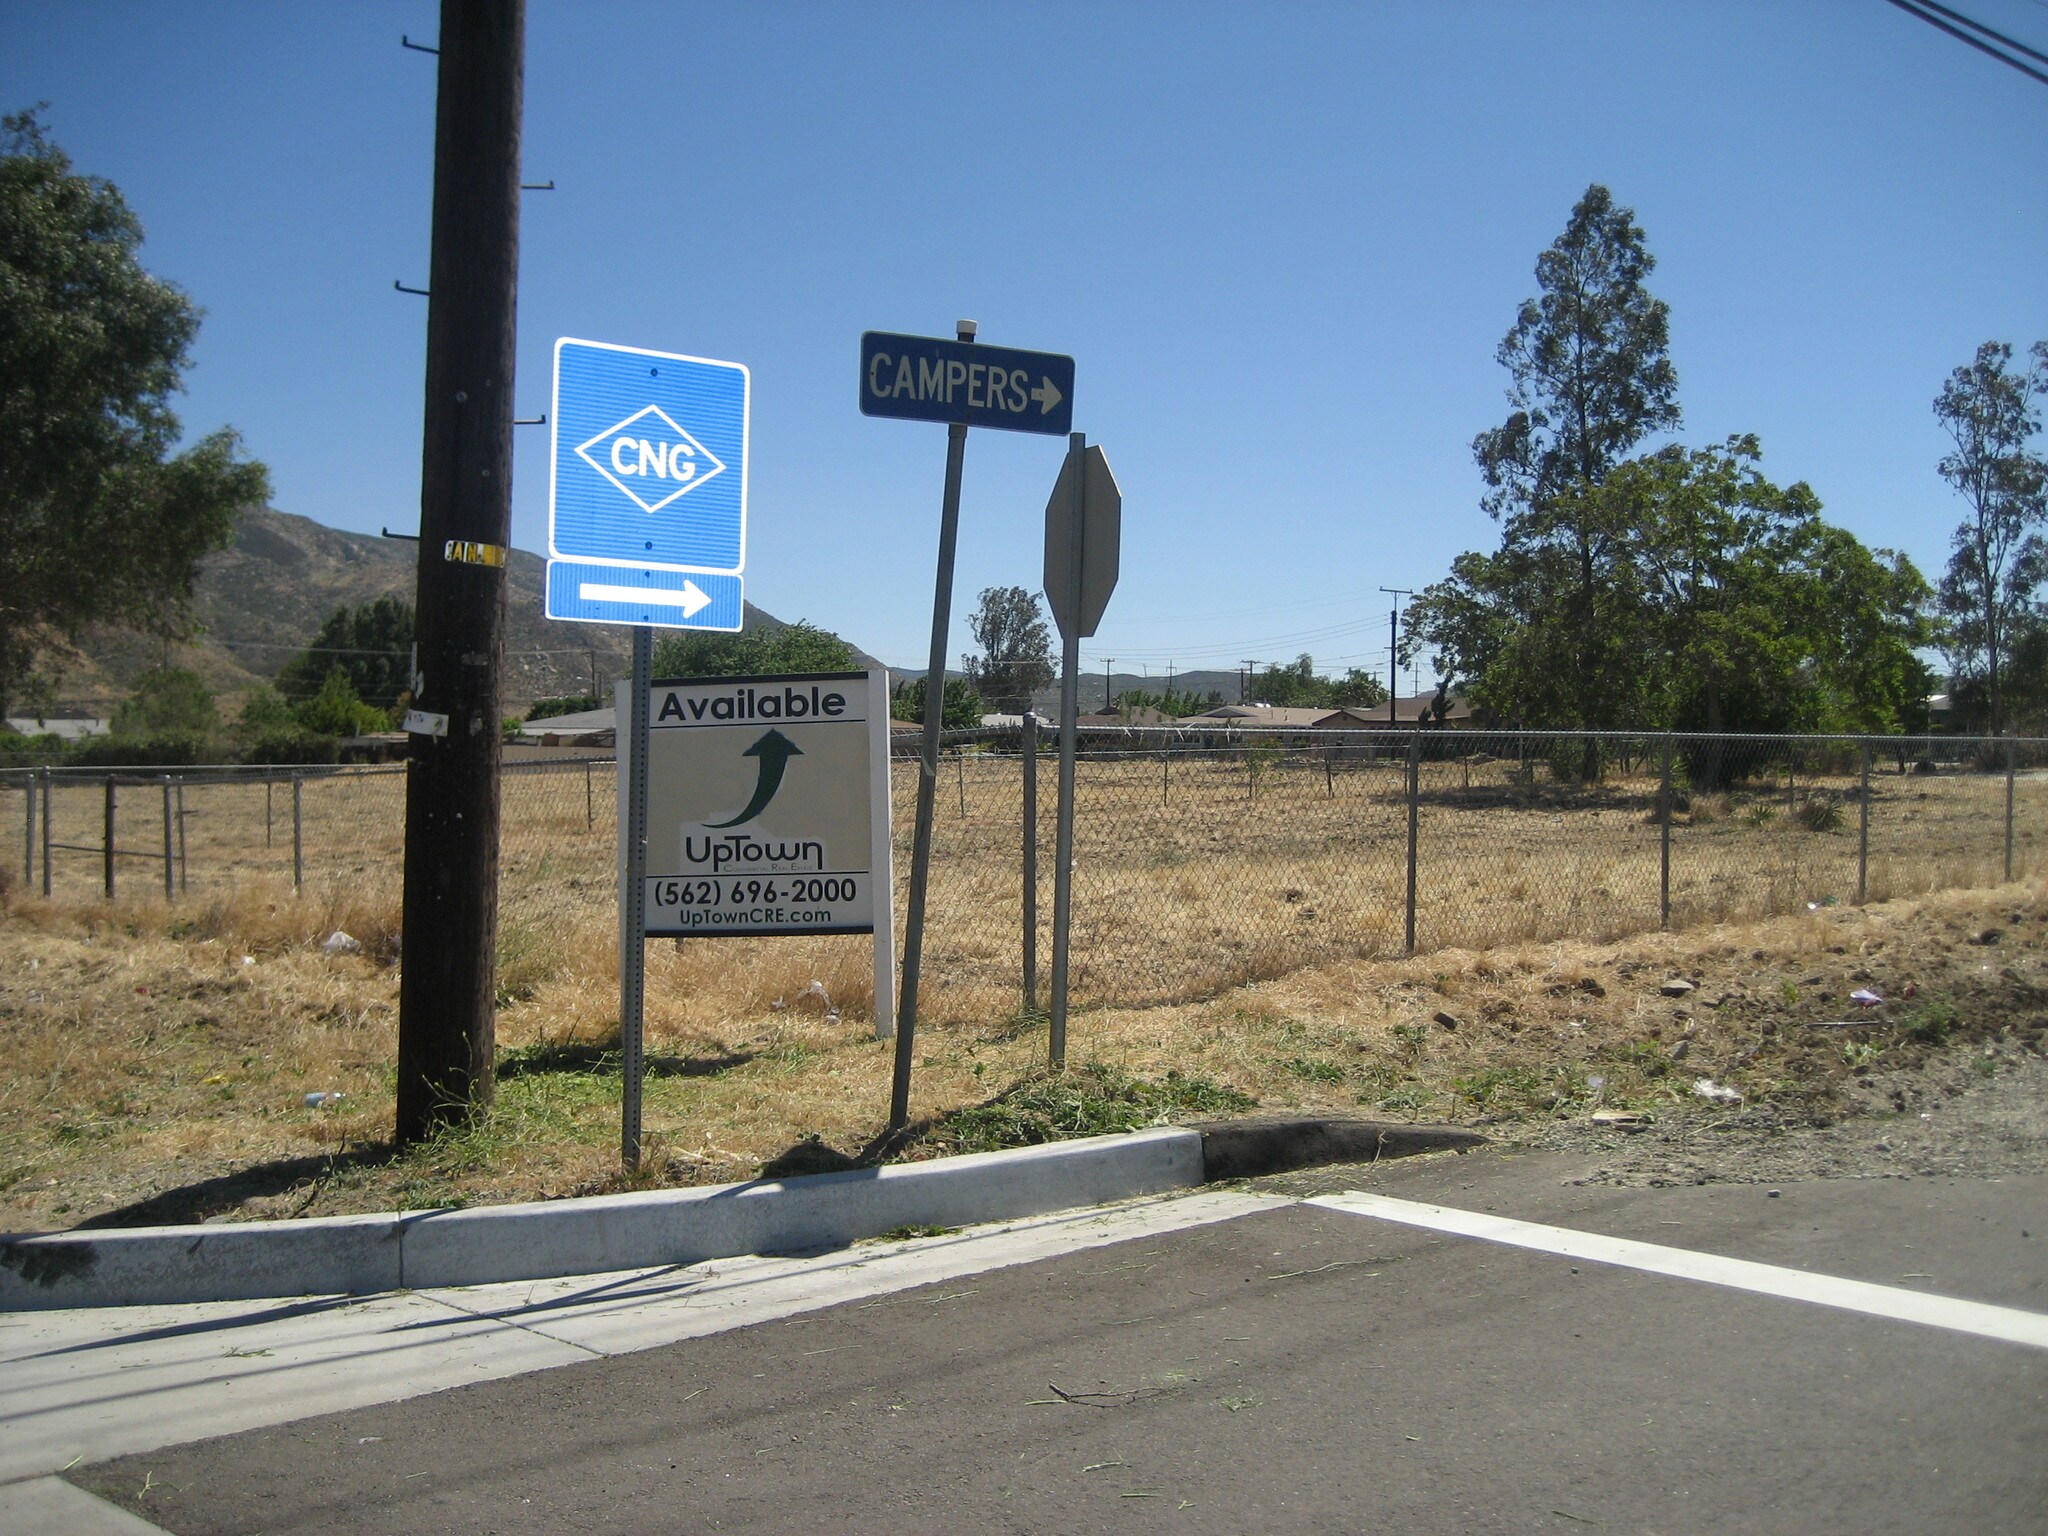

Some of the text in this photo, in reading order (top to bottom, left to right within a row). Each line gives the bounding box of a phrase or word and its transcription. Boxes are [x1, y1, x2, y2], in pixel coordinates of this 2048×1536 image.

[869, 352, 1028, 412] CAMPERS
[611, 436, 696, 481] CNG
[658, 686, 846, 722] Available
[685, 835, 823, 872] UpTown
[655, 878, 857, 906] (562) 696-2000
[680, 908, 831, 927] UpTownCRE.com
